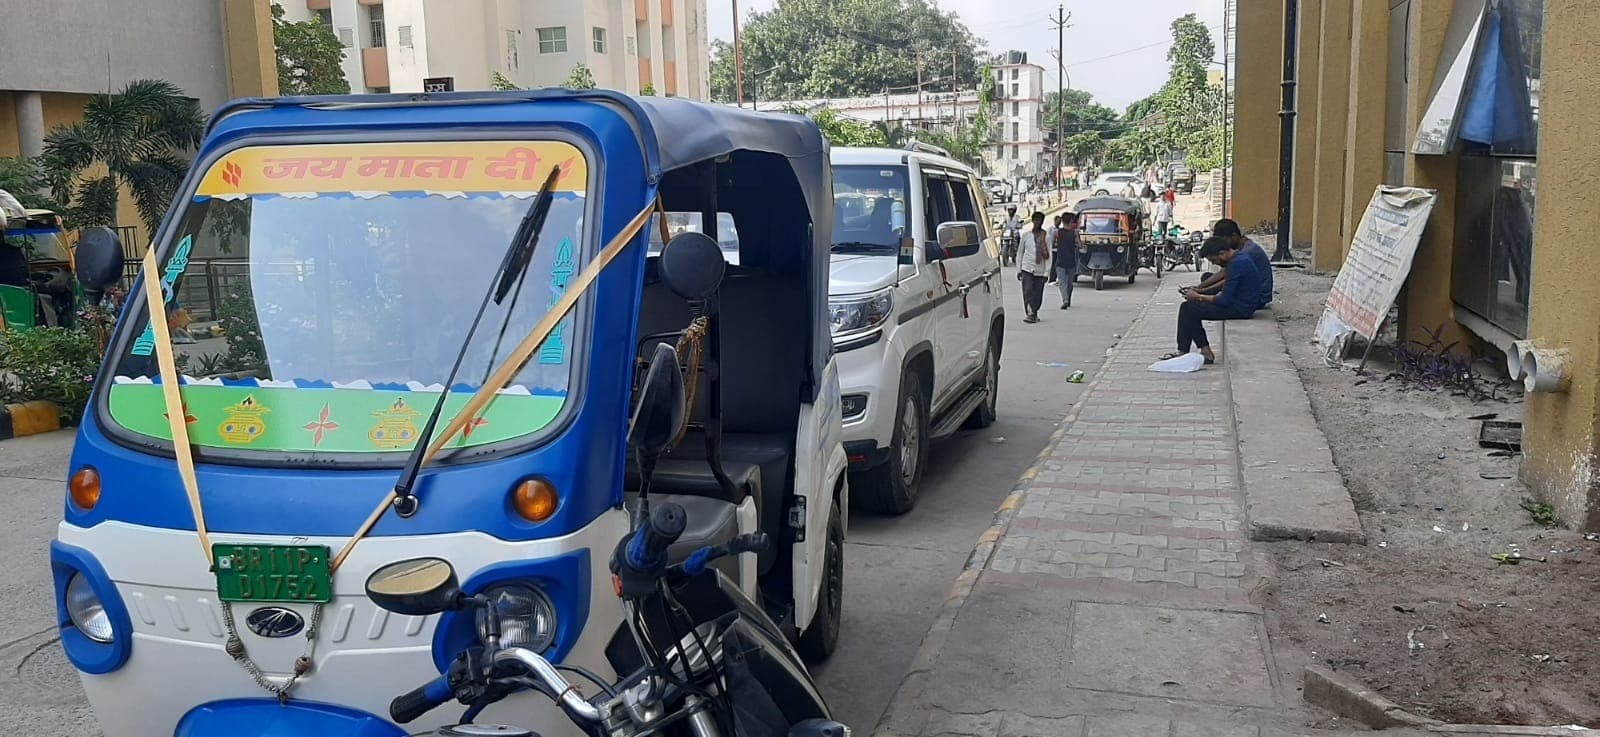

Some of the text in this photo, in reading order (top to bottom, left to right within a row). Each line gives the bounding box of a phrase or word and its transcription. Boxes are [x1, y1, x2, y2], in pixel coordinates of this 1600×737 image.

[262, 147, 540, 180] जय माता दी
[233, 547, 310, 572] BR11P
[239, 574, 317, 599] D1752
